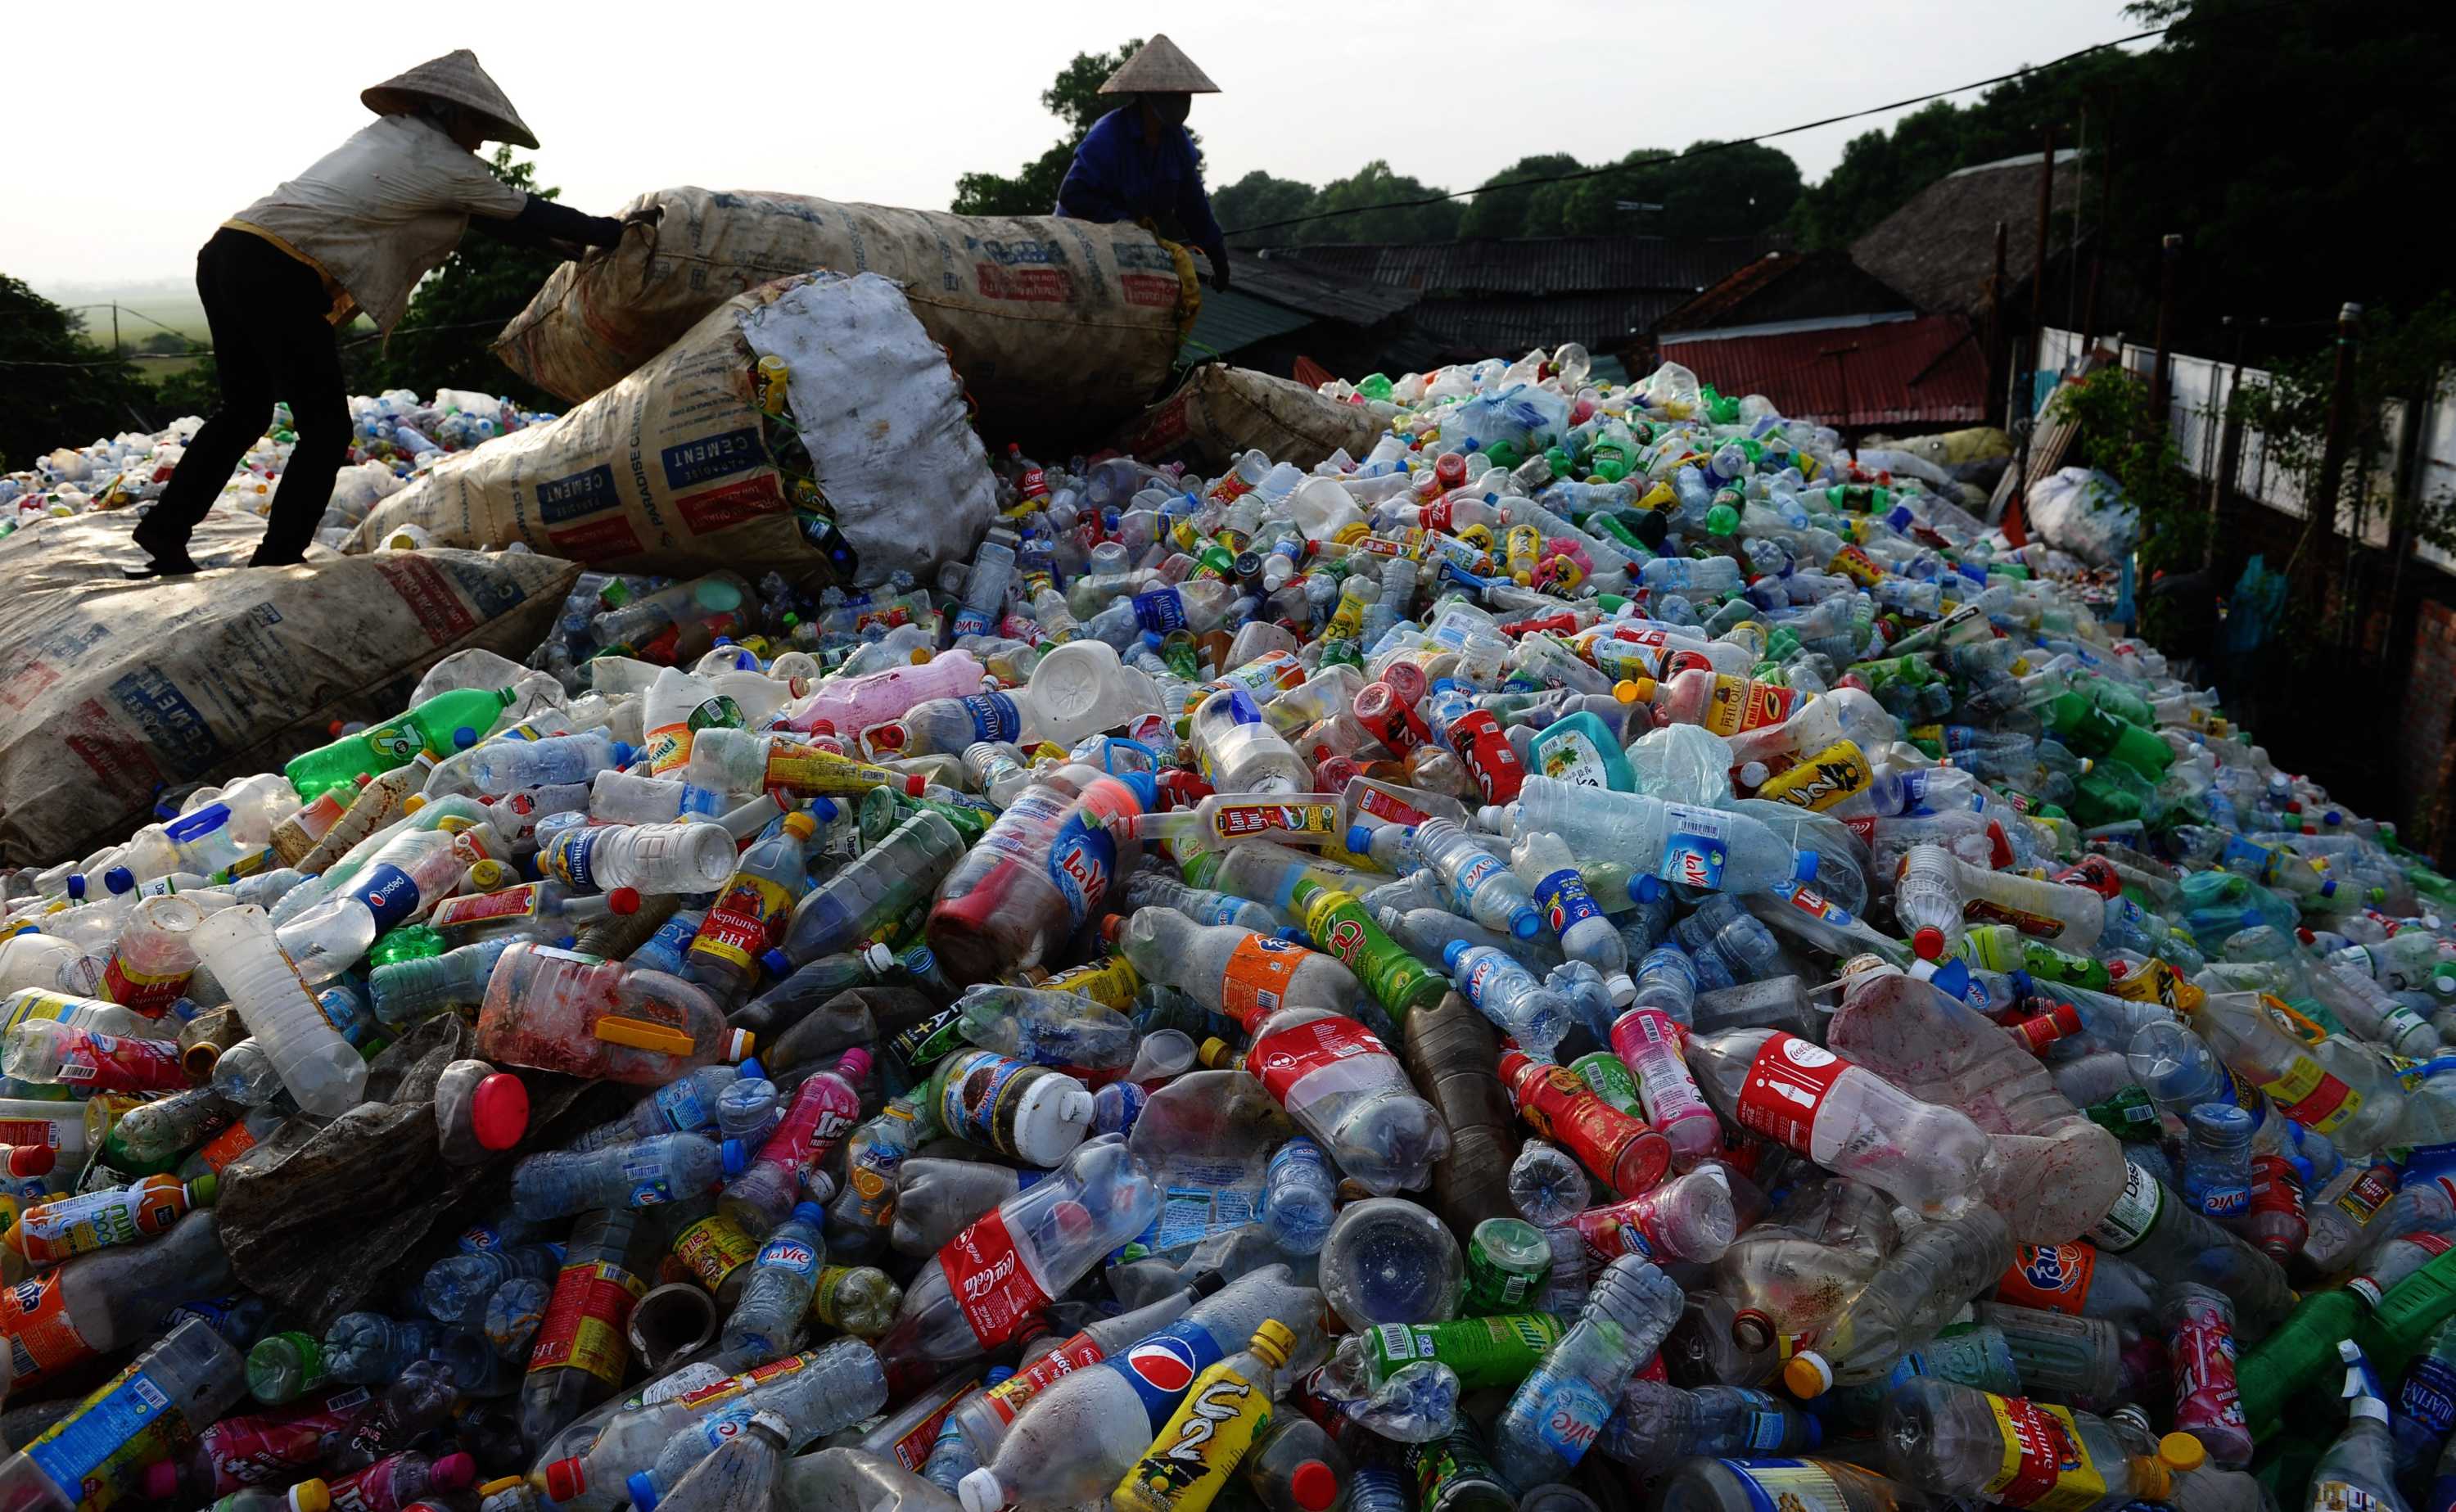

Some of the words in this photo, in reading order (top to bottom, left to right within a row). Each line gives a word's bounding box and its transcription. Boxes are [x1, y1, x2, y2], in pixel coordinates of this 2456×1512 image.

[673, 437, 750, 468] CEMENT
[546, 474, 603, 503] CEMENT
[380, 874, 405, 898] pepsi
[708, 909, 759, 934] Neptune
[963, 1249, 1016, 1303] Coca-Cola
[2010, 1419, 2037, 1456] 1:1:1
